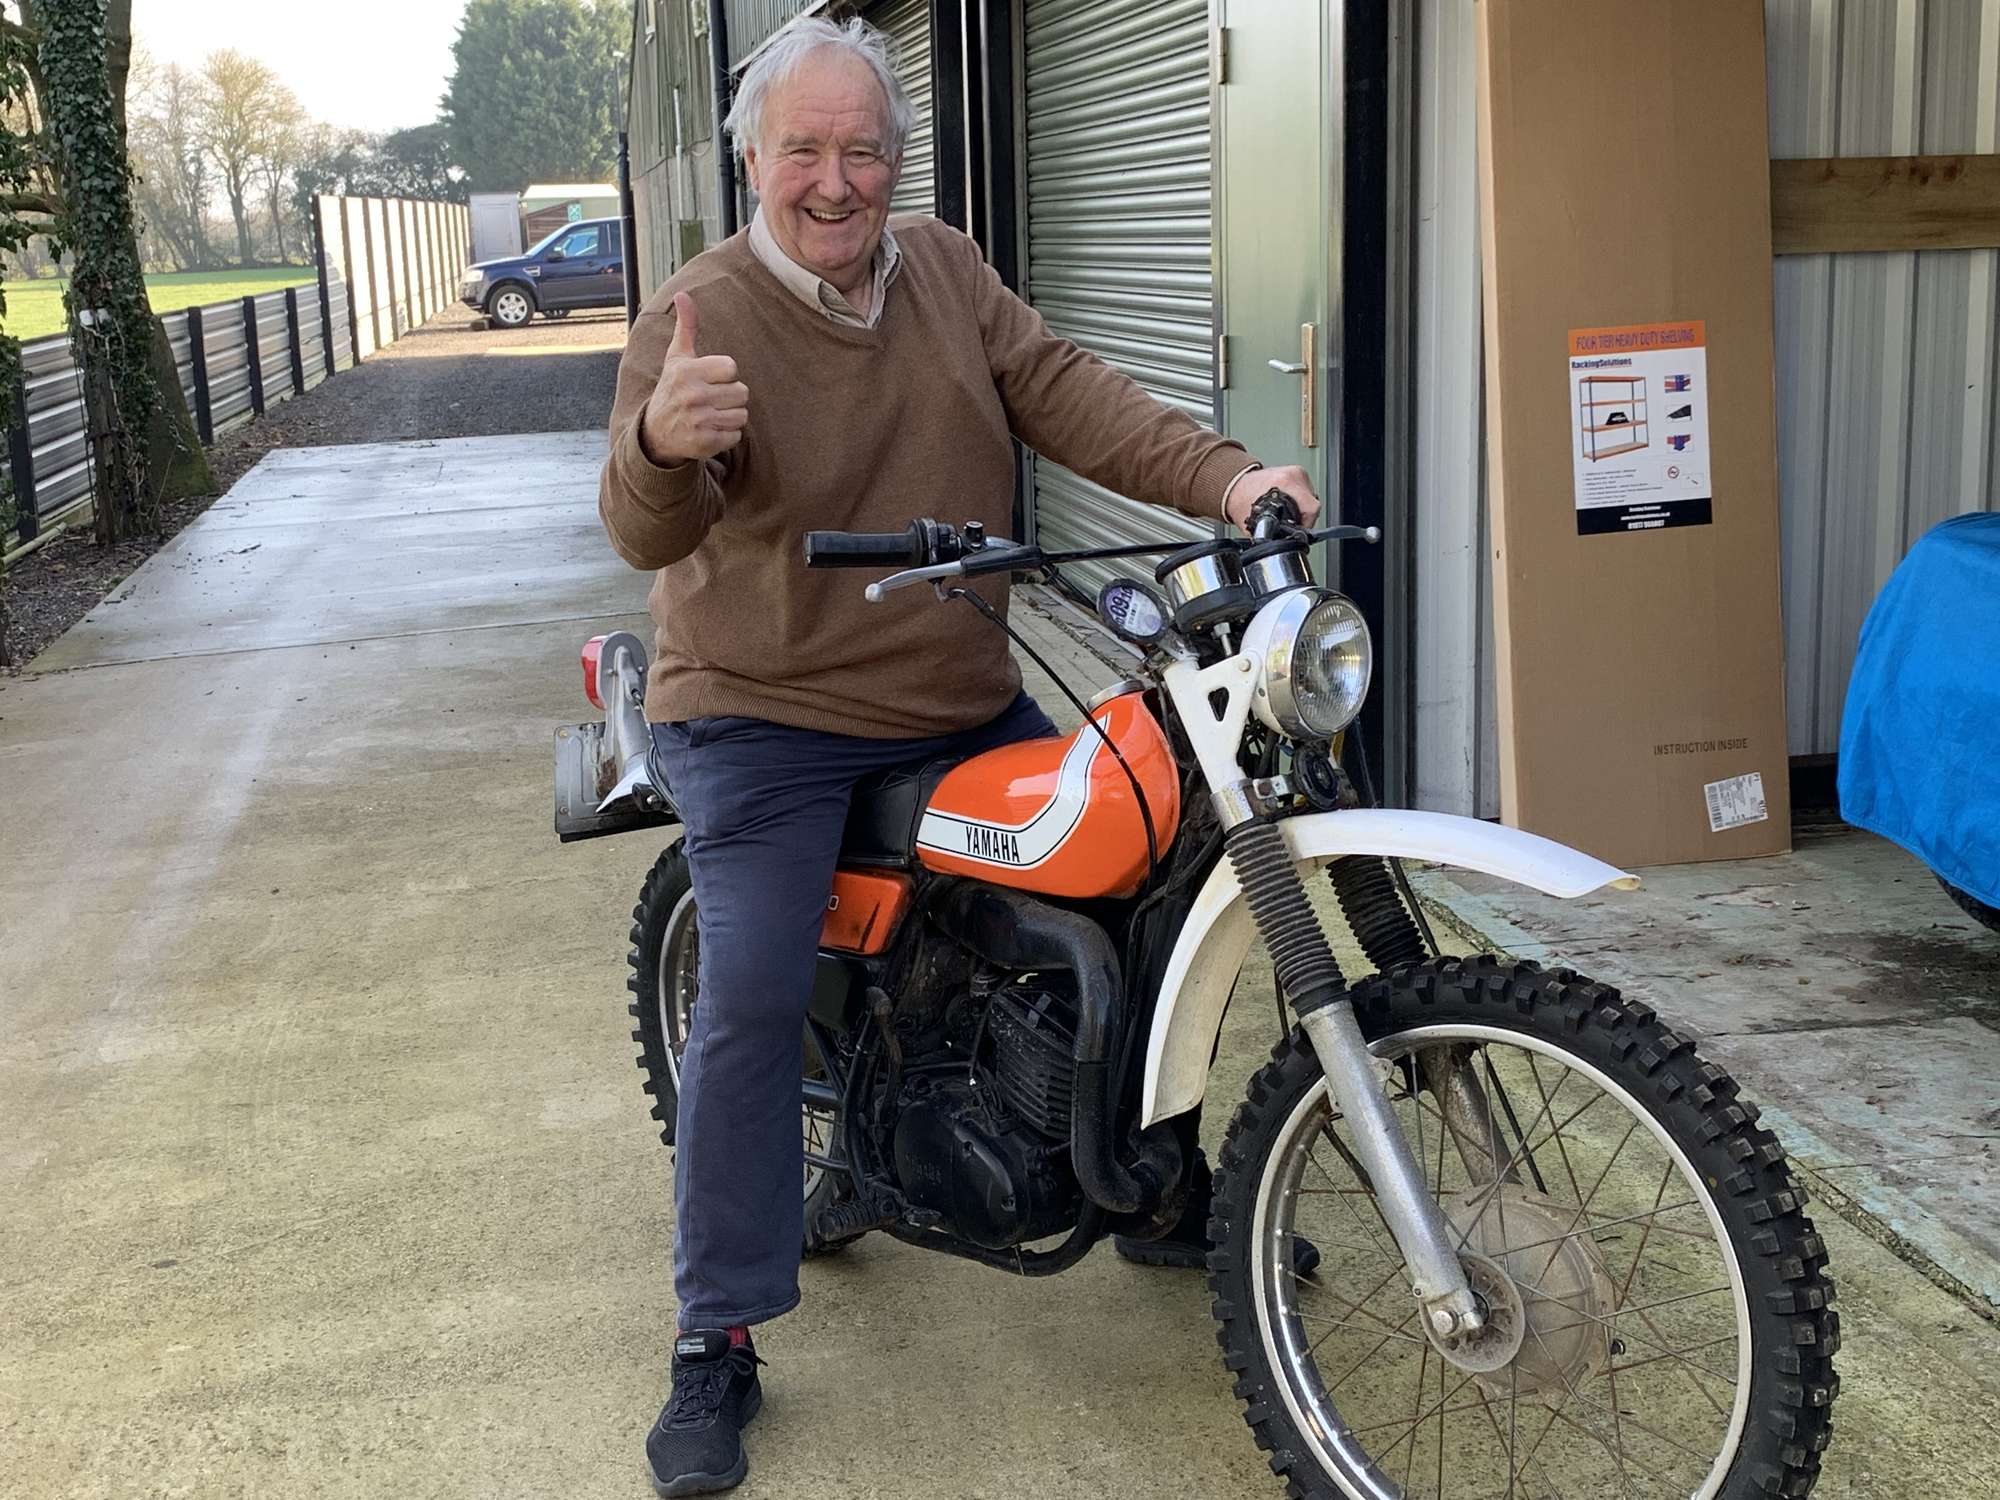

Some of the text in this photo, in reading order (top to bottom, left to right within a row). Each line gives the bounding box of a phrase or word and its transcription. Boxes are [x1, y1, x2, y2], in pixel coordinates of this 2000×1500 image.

[1576, 328, 1696, 351] FOUR TIER HEAVY DUTY SHELVING
[1110, 596, 1129, 617] 09
[1654, 738, 1748, 755] INSTRUCTION INSIDE
[966, 826, 1020, 862] YAMAHA
